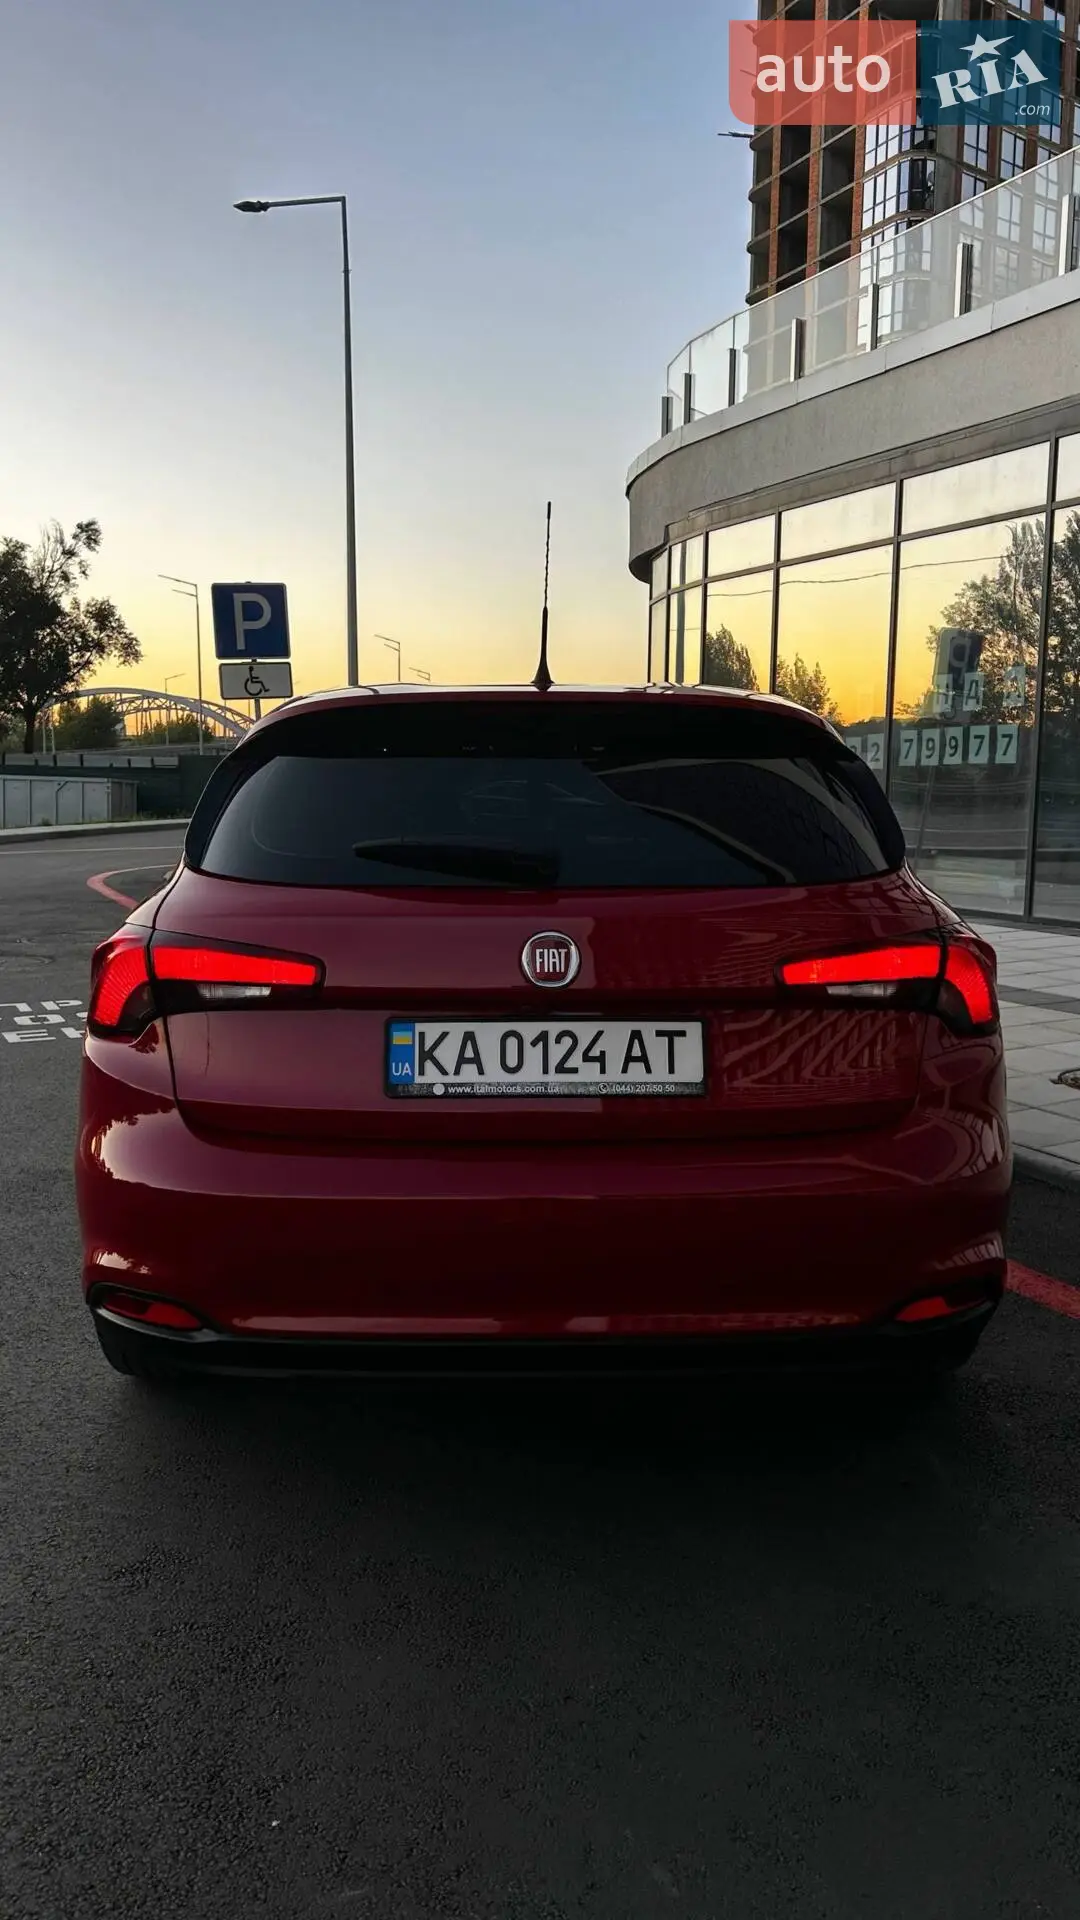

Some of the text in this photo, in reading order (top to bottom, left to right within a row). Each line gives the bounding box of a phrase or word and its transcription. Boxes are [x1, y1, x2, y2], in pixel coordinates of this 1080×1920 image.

[232, 592, 272, 651] P
[535, 948, 568, 973] FIAT
[392, 1062, 412, 1076] UA
[418, 1029, 687, 1076] KA 0124 AT
